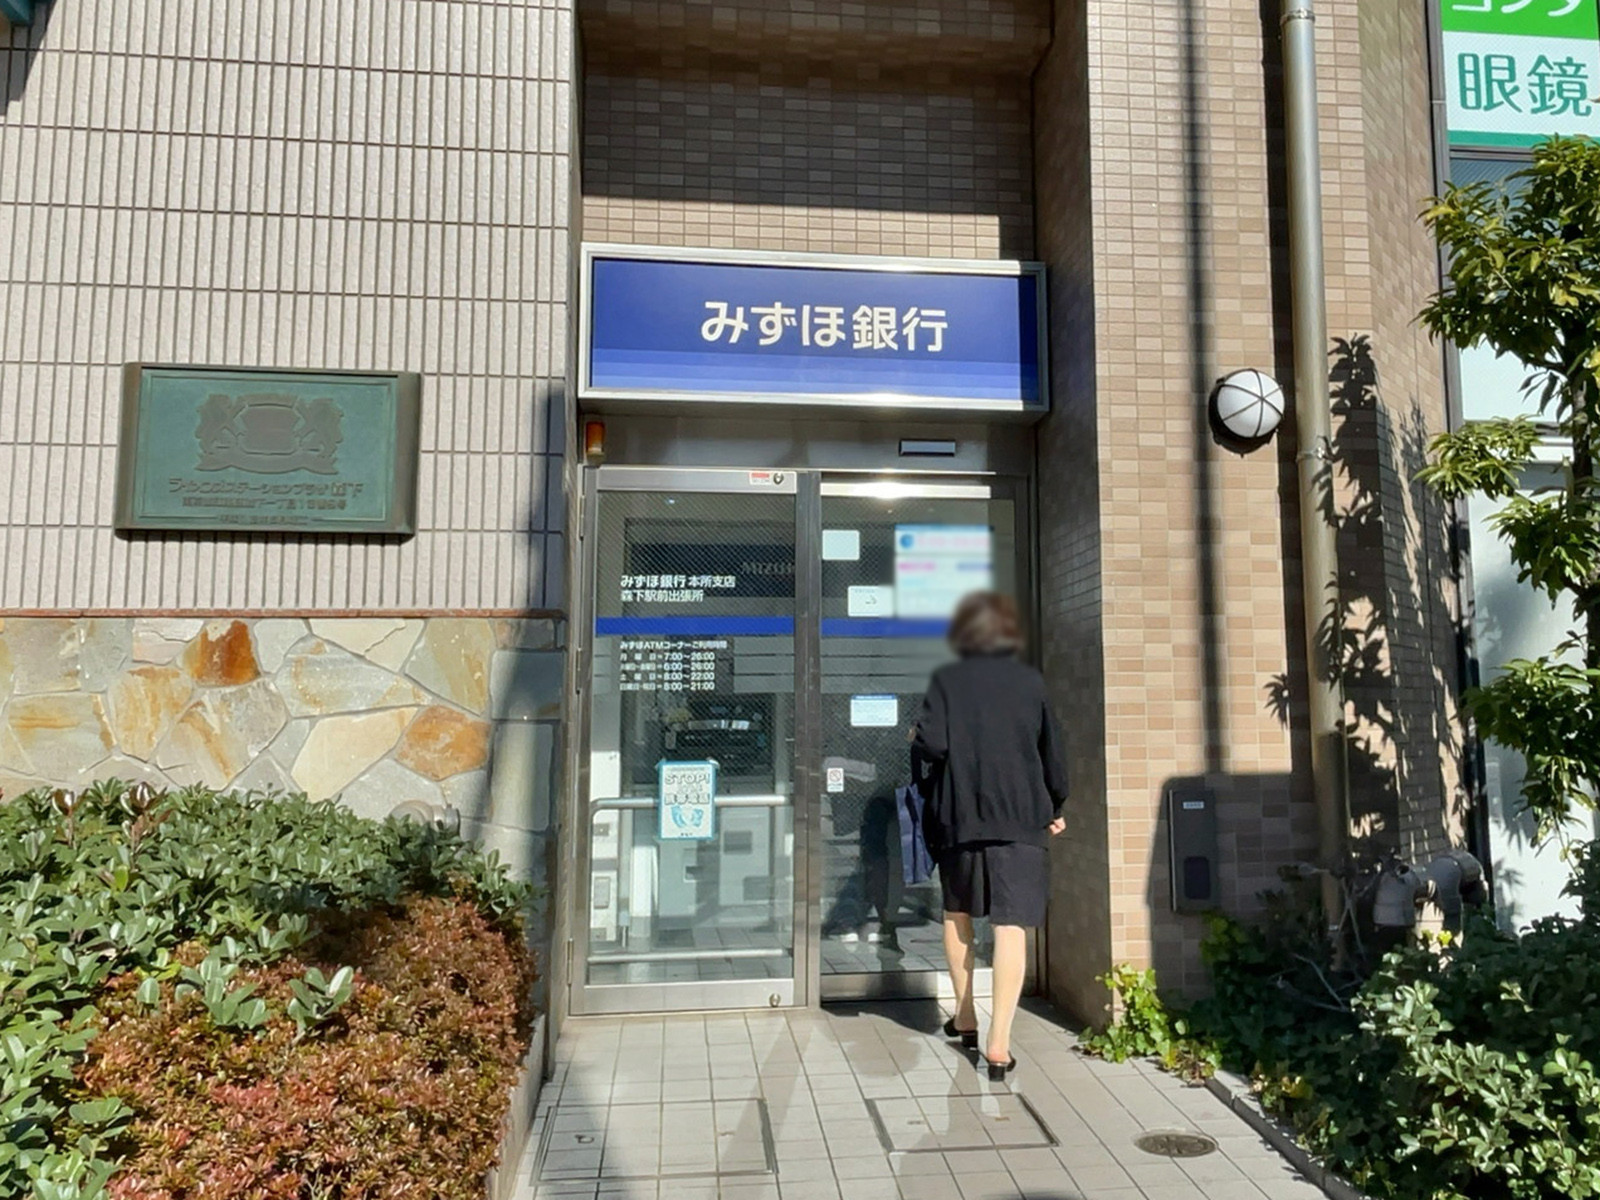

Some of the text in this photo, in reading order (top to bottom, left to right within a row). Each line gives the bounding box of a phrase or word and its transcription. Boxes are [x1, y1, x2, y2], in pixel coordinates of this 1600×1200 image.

[1458, 53, 1592, 117] 眼鏡
[701, 301, 949, 352] みずほ銀行
[620, 574, 736, 588] みずほ銀行 本所支店
[620, 589, 704, 603] 森下駅前出張所
